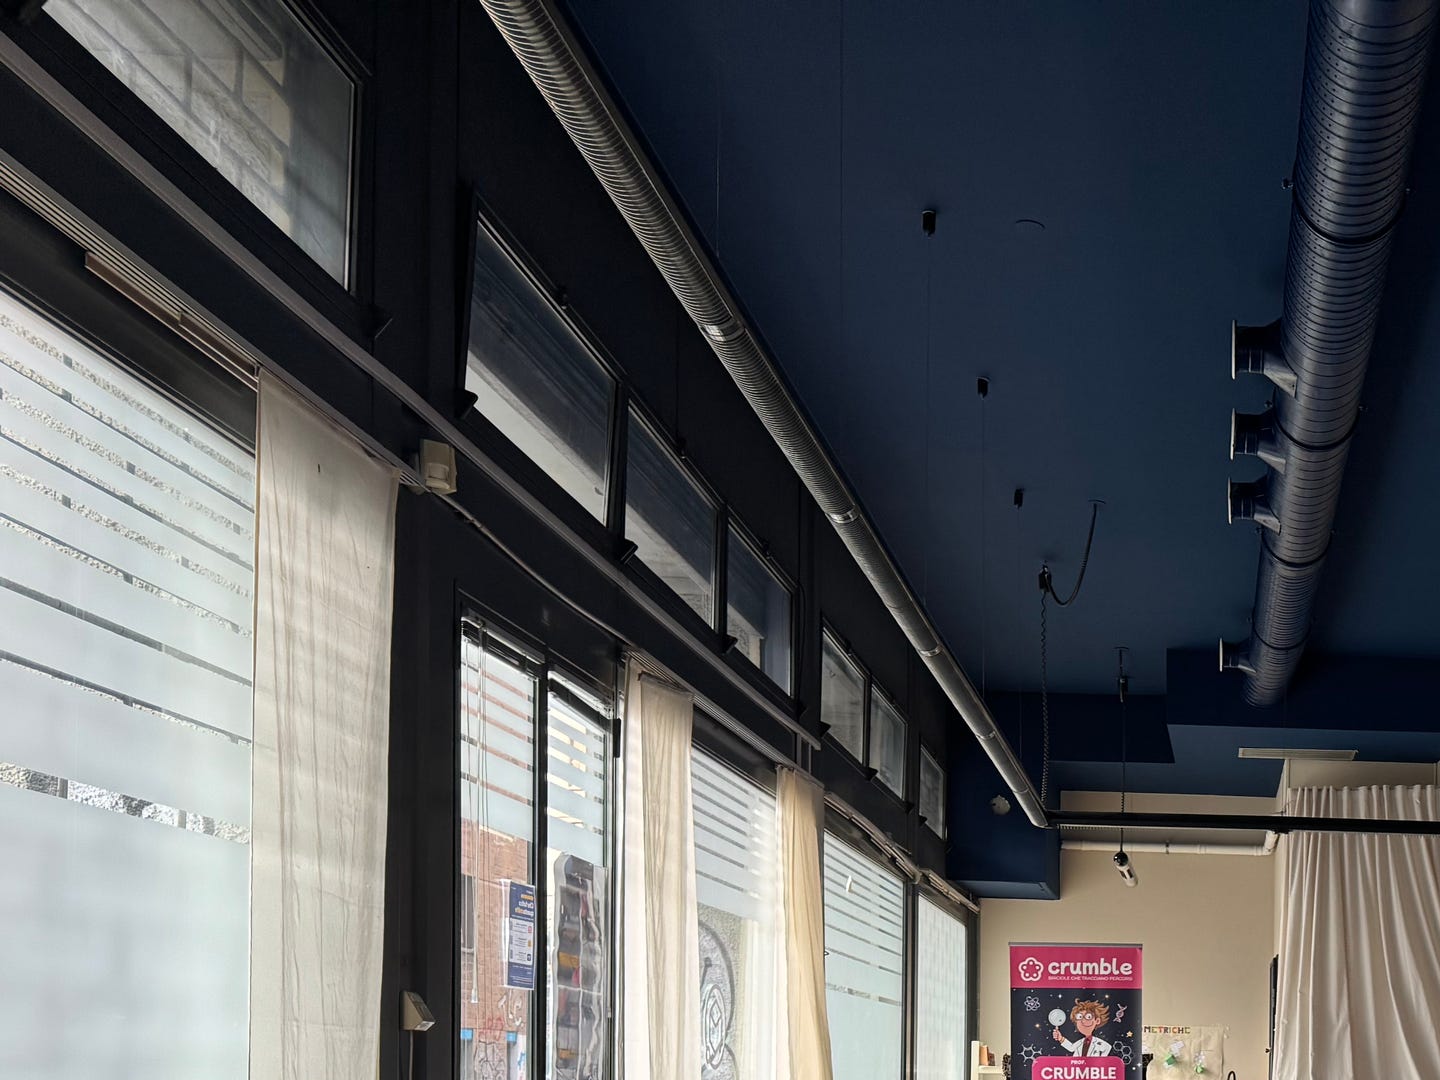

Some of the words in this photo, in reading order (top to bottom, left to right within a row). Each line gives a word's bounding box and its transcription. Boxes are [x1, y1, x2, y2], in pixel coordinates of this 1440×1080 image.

[1047, 957, 1133, 975] crumble
[1143, 1025, 1191, 1034] METRICHE
[1041, 1066, 1117, 1080] CRUMBLE
